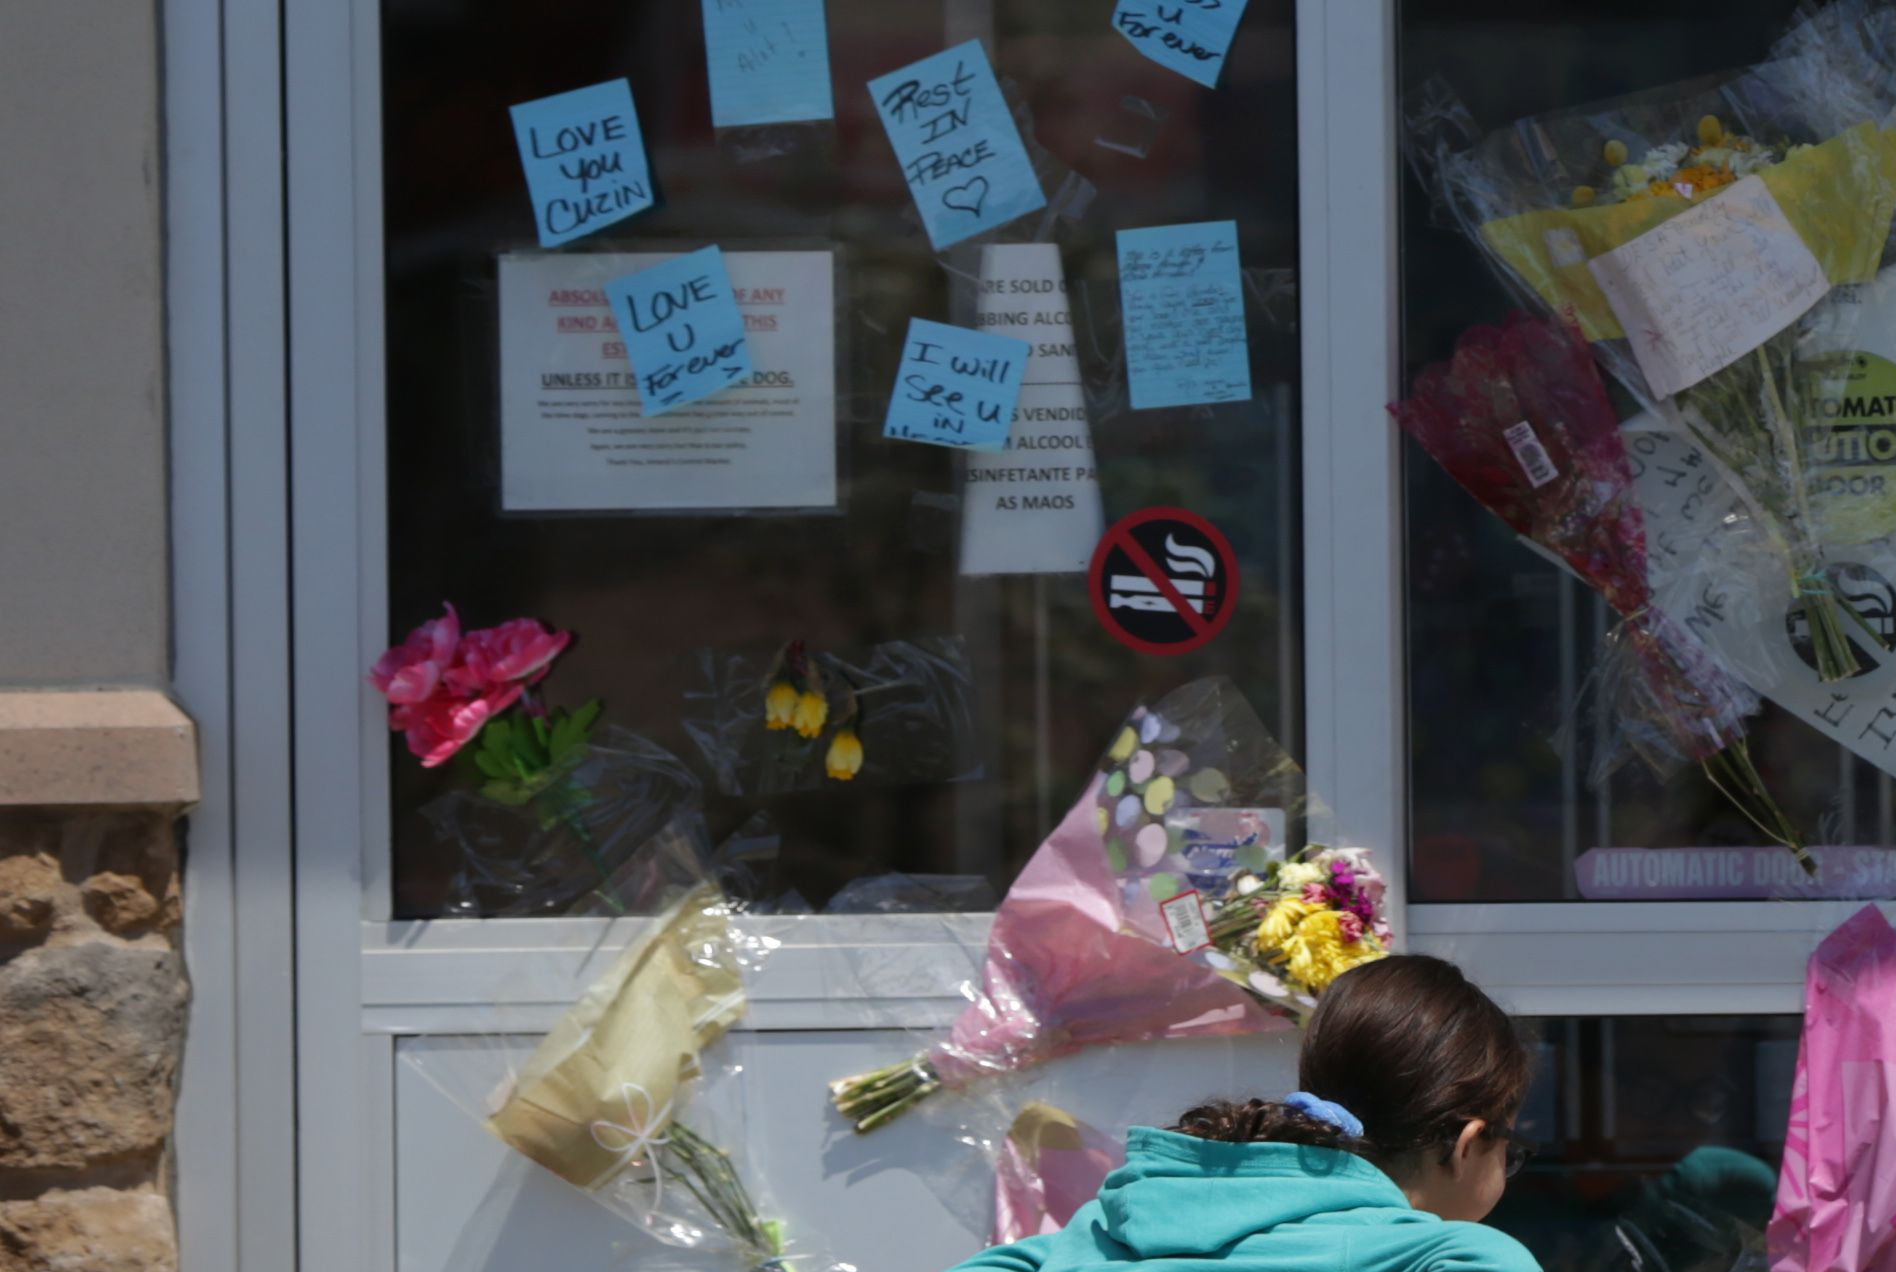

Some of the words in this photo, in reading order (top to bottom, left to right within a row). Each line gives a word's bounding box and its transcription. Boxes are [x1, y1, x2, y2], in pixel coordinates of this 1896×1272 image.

[882, 61, 976, 122] Rest
[920, 99, 972, 145] IN
[529, 115, 626, 160] LOVE
[907, 140, 995, 185] PEACE
[751, 288, 785, 302] ANY
[1010, 280, 1054, 294] SOLD
[626, 275, 718, 333] LOVE
[557, 316, 599, 330] KIND
[743, 314, 777, 329] THIS
[541, 372, 602, 387] UNLESS
[606, 372, 620, 386] IT
[1017, 435, 1083, 449] ALCOOL
[995, 494, 1018, 511] AS
[1593, 849, 1743, 887] AUTOMATIC
